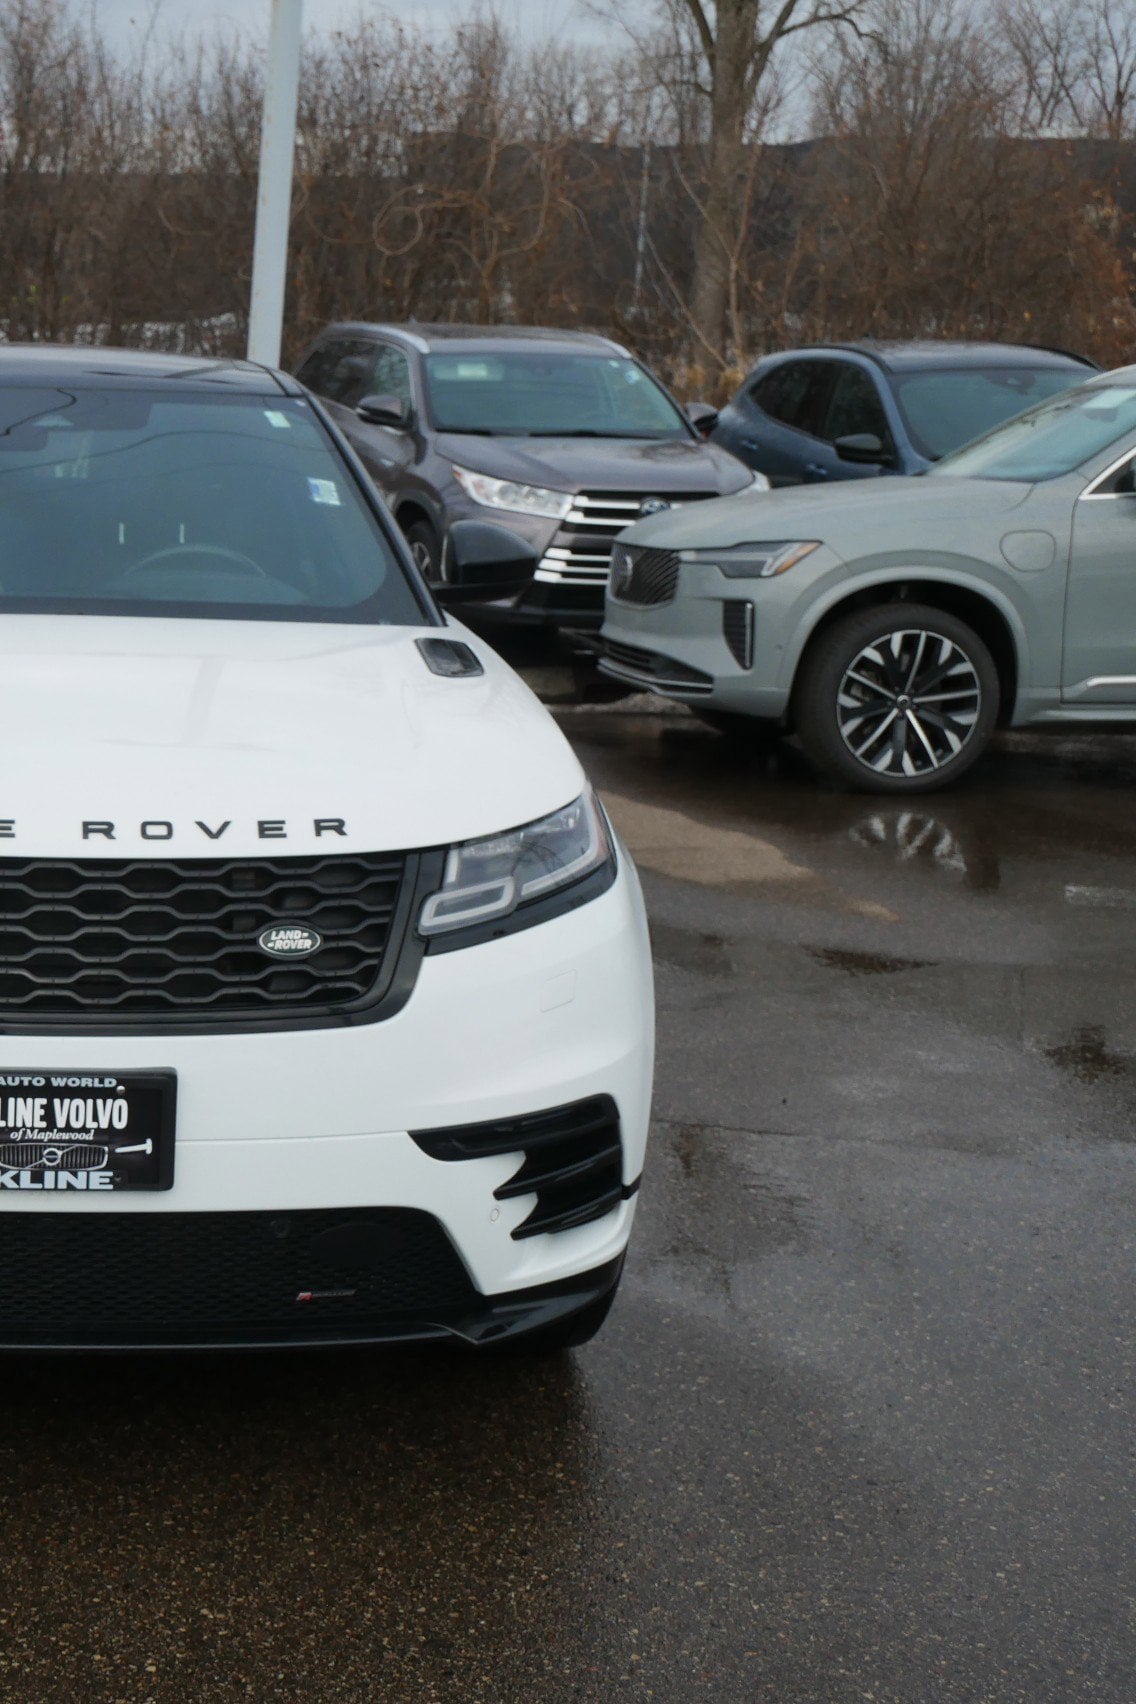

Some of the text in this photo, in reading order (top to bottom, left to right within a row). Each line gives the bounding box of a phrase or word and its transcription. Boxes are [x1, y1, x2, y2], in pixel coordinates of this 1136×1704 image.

[81, 817, 349, 840] ROVER
[50, 1076, 117, 1088] WORLD
[53, 1097, 129, 1130] VOLVO
[10, 1129, 95, 1142] of Maplewood
